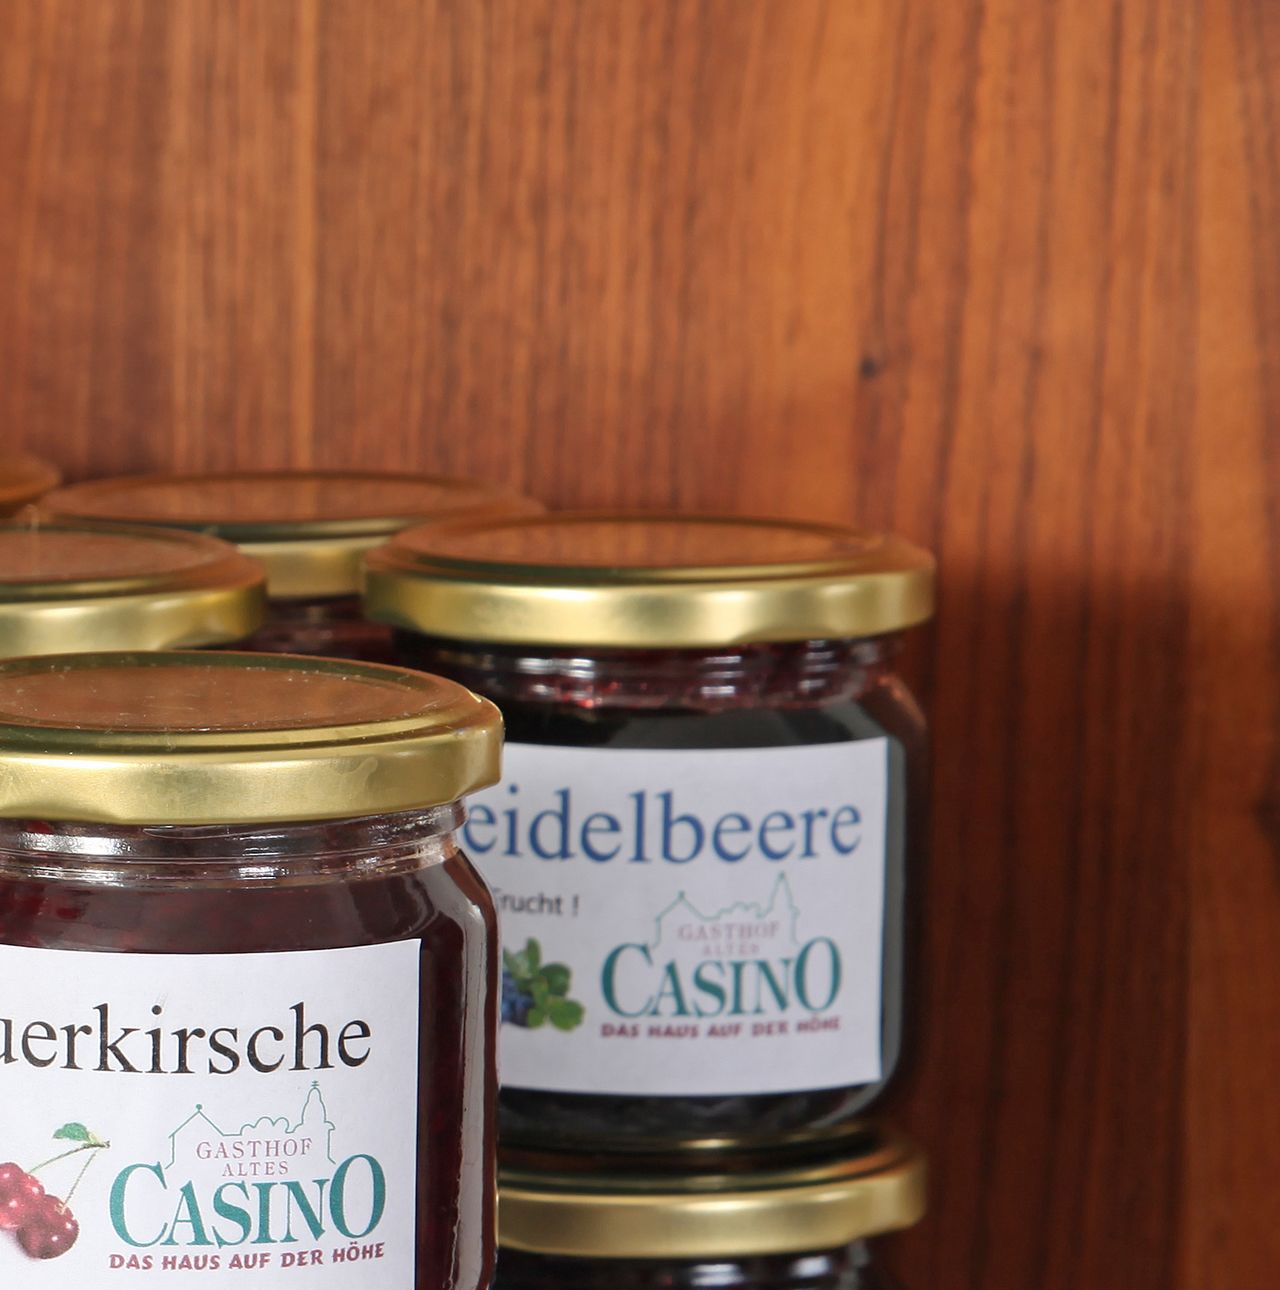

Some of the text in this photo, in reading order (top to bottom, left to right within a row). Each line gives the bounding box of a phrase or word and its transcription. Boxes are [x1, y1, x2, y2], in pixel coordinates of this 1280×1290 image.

[462, 784, 862, 864] eidelbeere
[600, 936, 843, 1018] CASINO
[196, 1137, 313, 1161] GASTHOF
[222, 1160, 289, 1177] ALTES
[109, 1153, 386, 1249] CASINO
[109, 1241, 385, 1271] DAS HAUS AUF DER HÖHE
